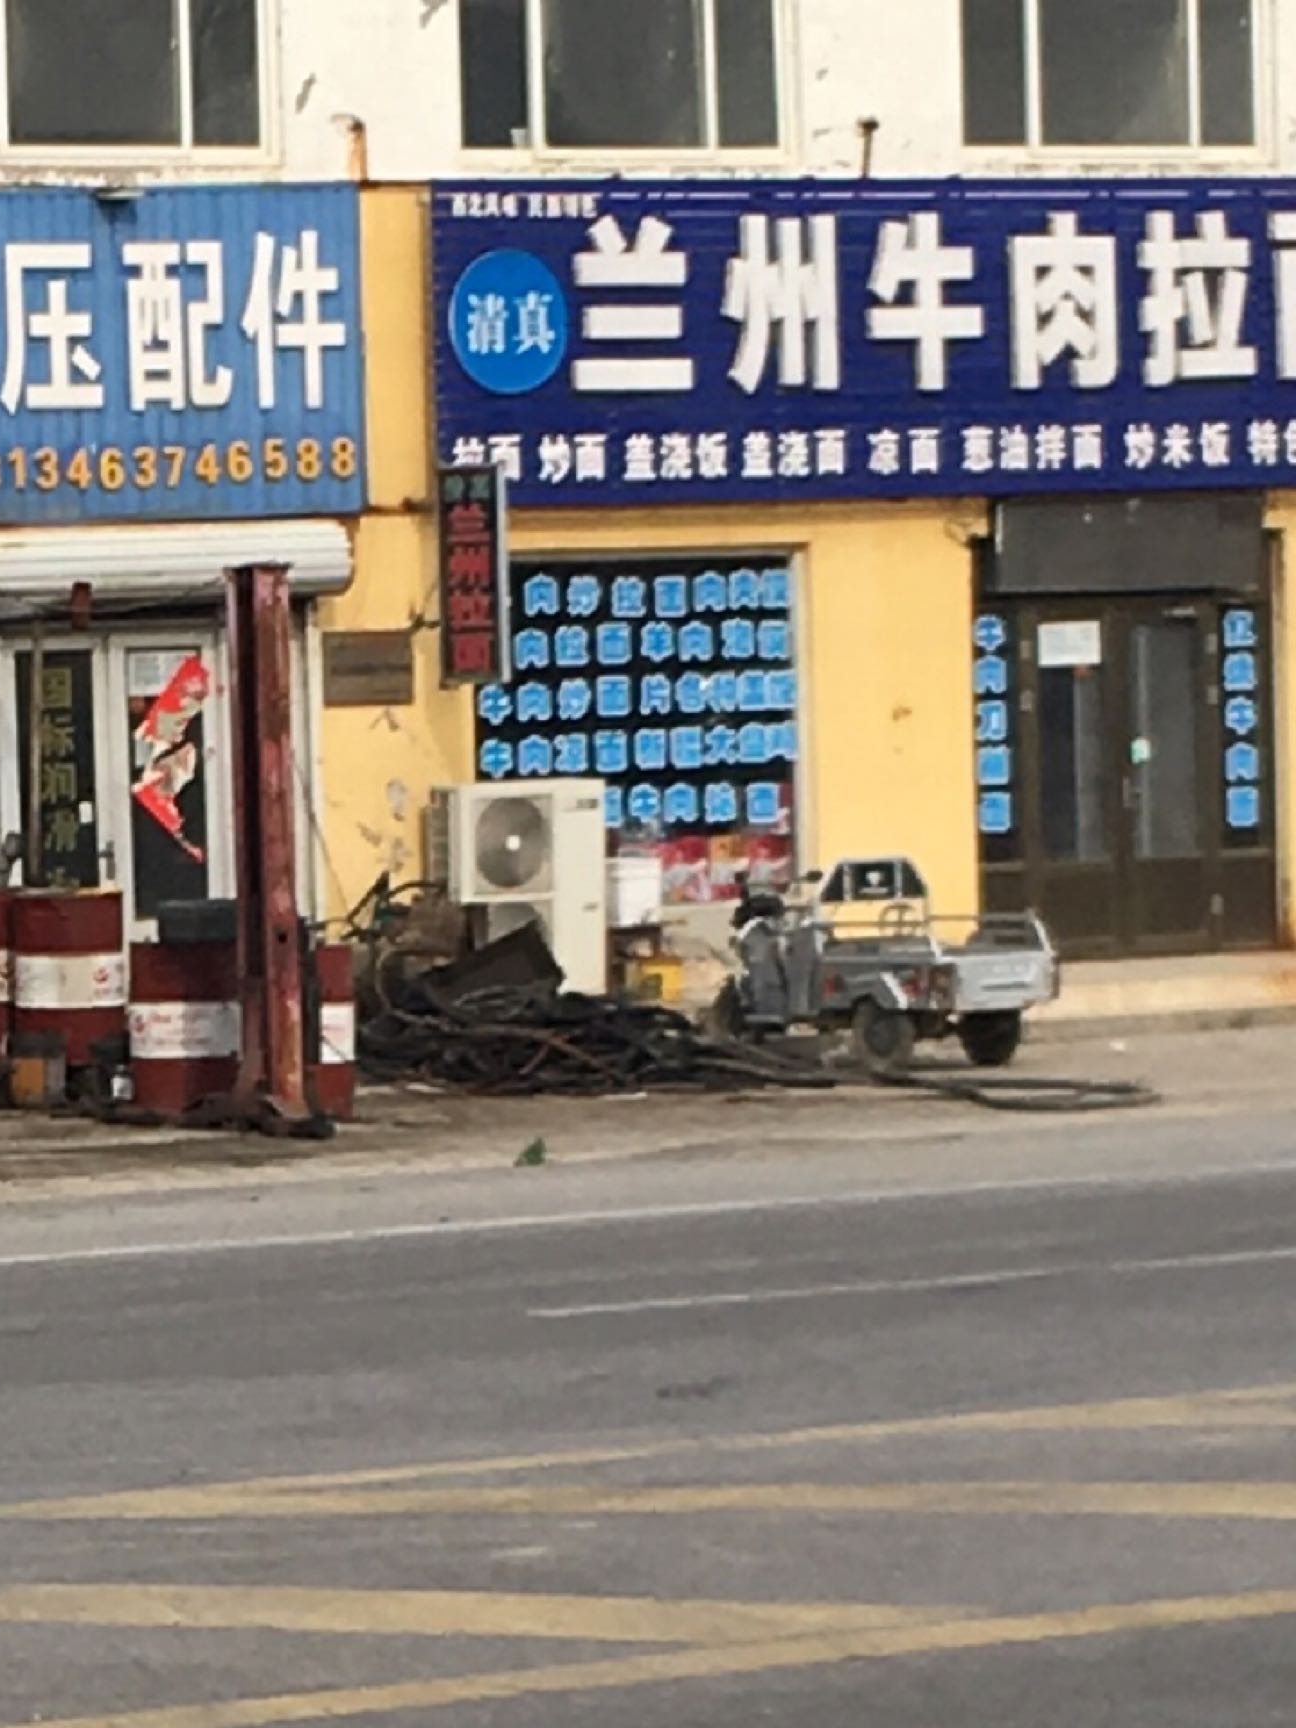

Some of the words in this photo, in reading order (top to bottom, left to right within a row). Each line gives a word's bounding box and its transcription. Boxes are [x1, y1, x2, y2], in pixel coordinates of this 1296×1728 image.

[467, 290, 555, 354] 清真
[571, 211, 1296, 394] 兰州牛肉拉
[538, 432, 608, 484] 炒面
[623, 431, 728, 481] 盖浇饭
[741, 428, 849, 477] 盖浇面
[1123, 421, 1231, 469] 炒米饭
